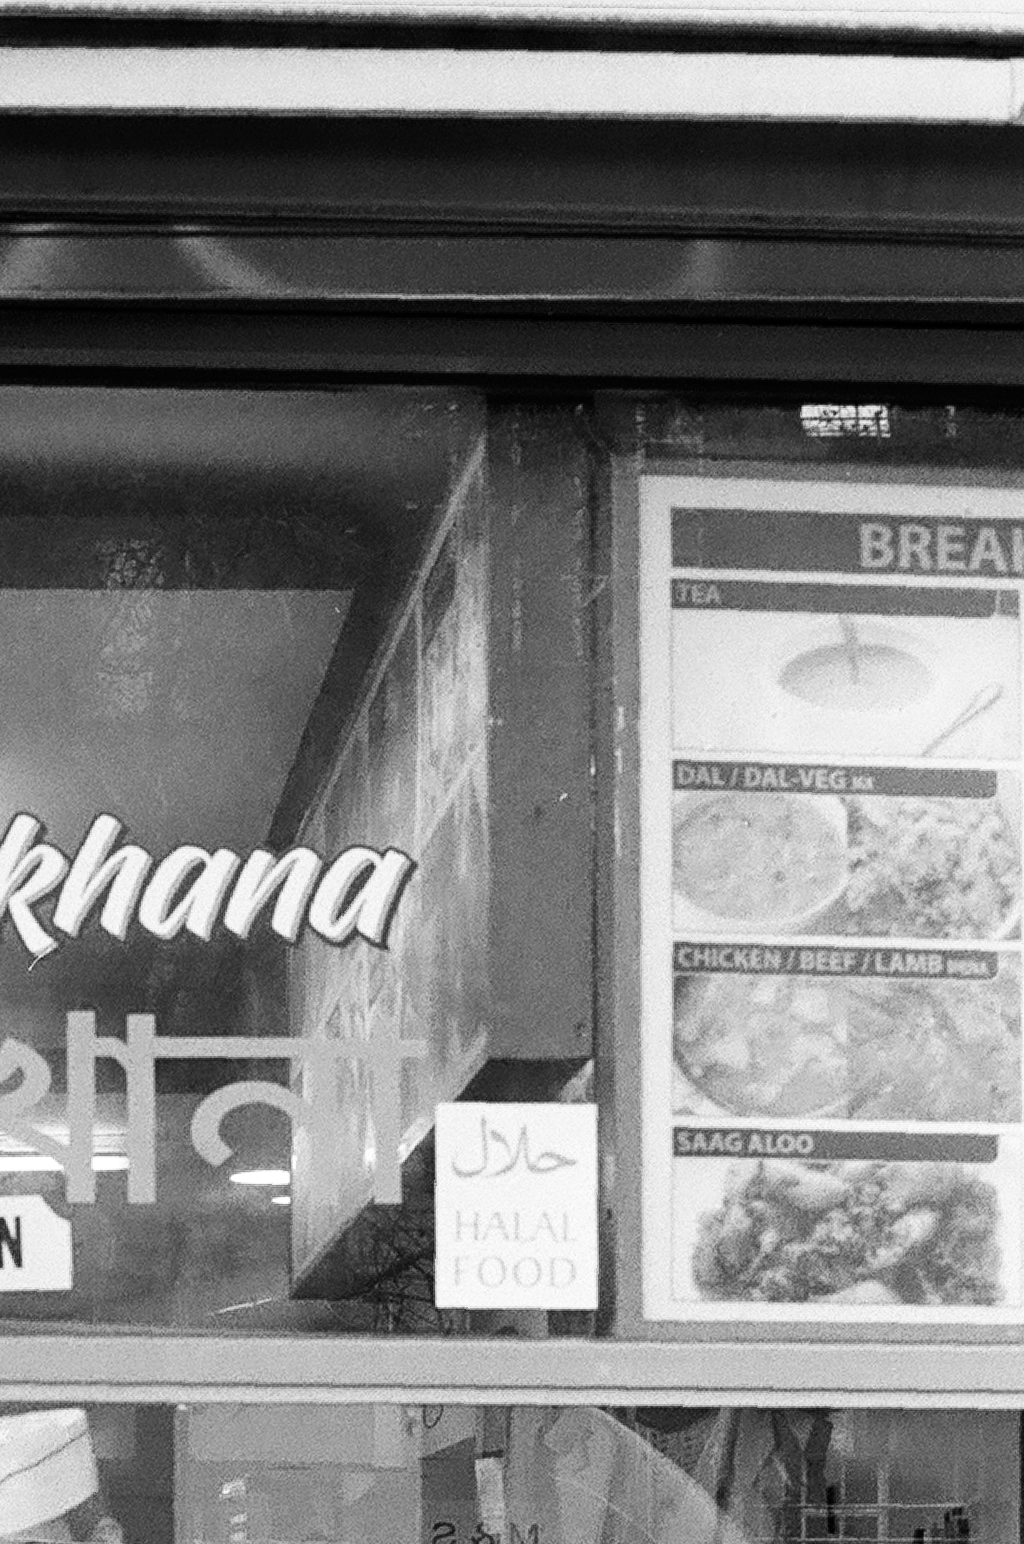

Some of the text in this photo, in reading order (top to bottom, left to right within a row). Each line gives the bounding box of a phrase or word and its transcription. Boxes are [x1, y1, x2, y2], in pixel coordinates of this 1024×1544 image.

[860, 521, 1024, 575] BREA
[677, 582, 721, 605] TEA
[677, 765, 724, 786] DAL
[744, 767, 846, 790] DAL-VEG
[678, 946, 783, 972] CHICKEN
[799, 950, 857, 973] BEEF
[875, 951, 943, 975] LAMB
[452, 1115, 578, 1178] حلال
[677, 1130, 814, 1154] SAAG ALOO
[454, 1211, 576, 1242] HALAL
[454, 1256, 577, 1288] FOOD
